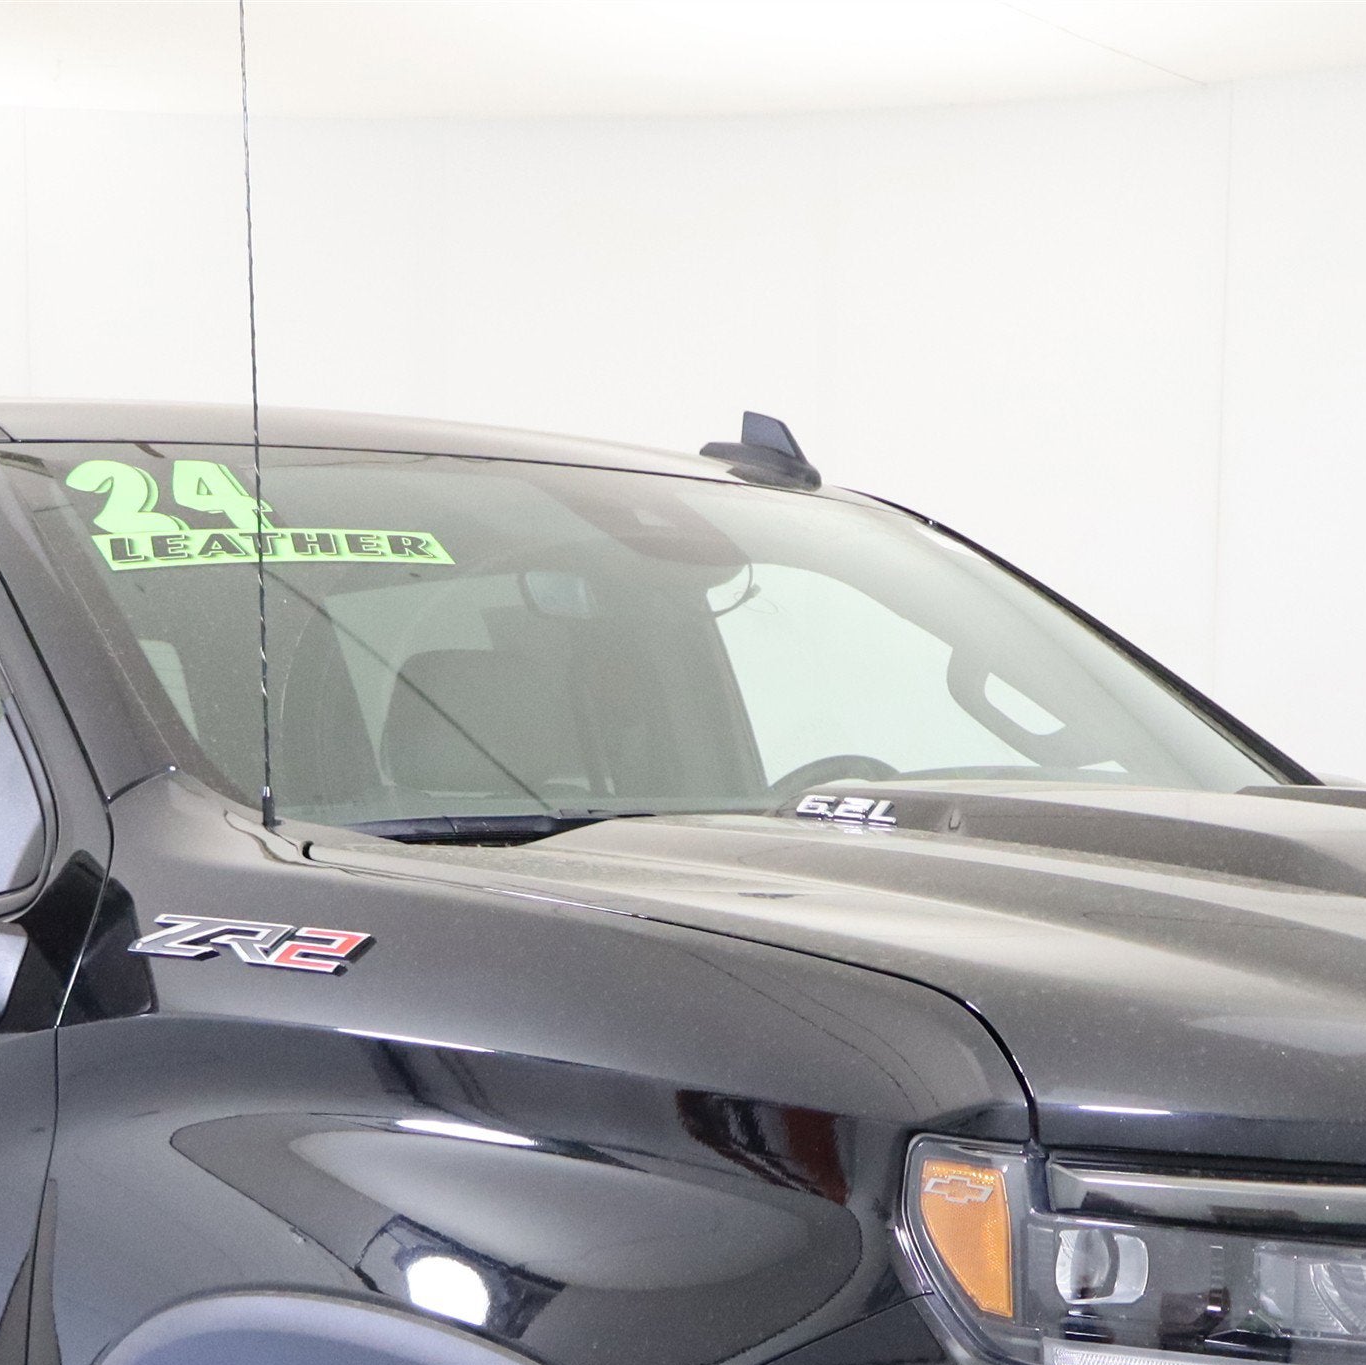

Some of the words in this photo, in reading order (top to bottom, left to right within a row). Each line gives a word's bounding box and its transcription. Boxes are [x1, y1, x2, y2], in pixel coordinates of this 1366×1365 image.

[65, 460, 273, 534] 24
[109, 531, 438, 565] LEATHER
[127, 913, 375, 976] ZR2
